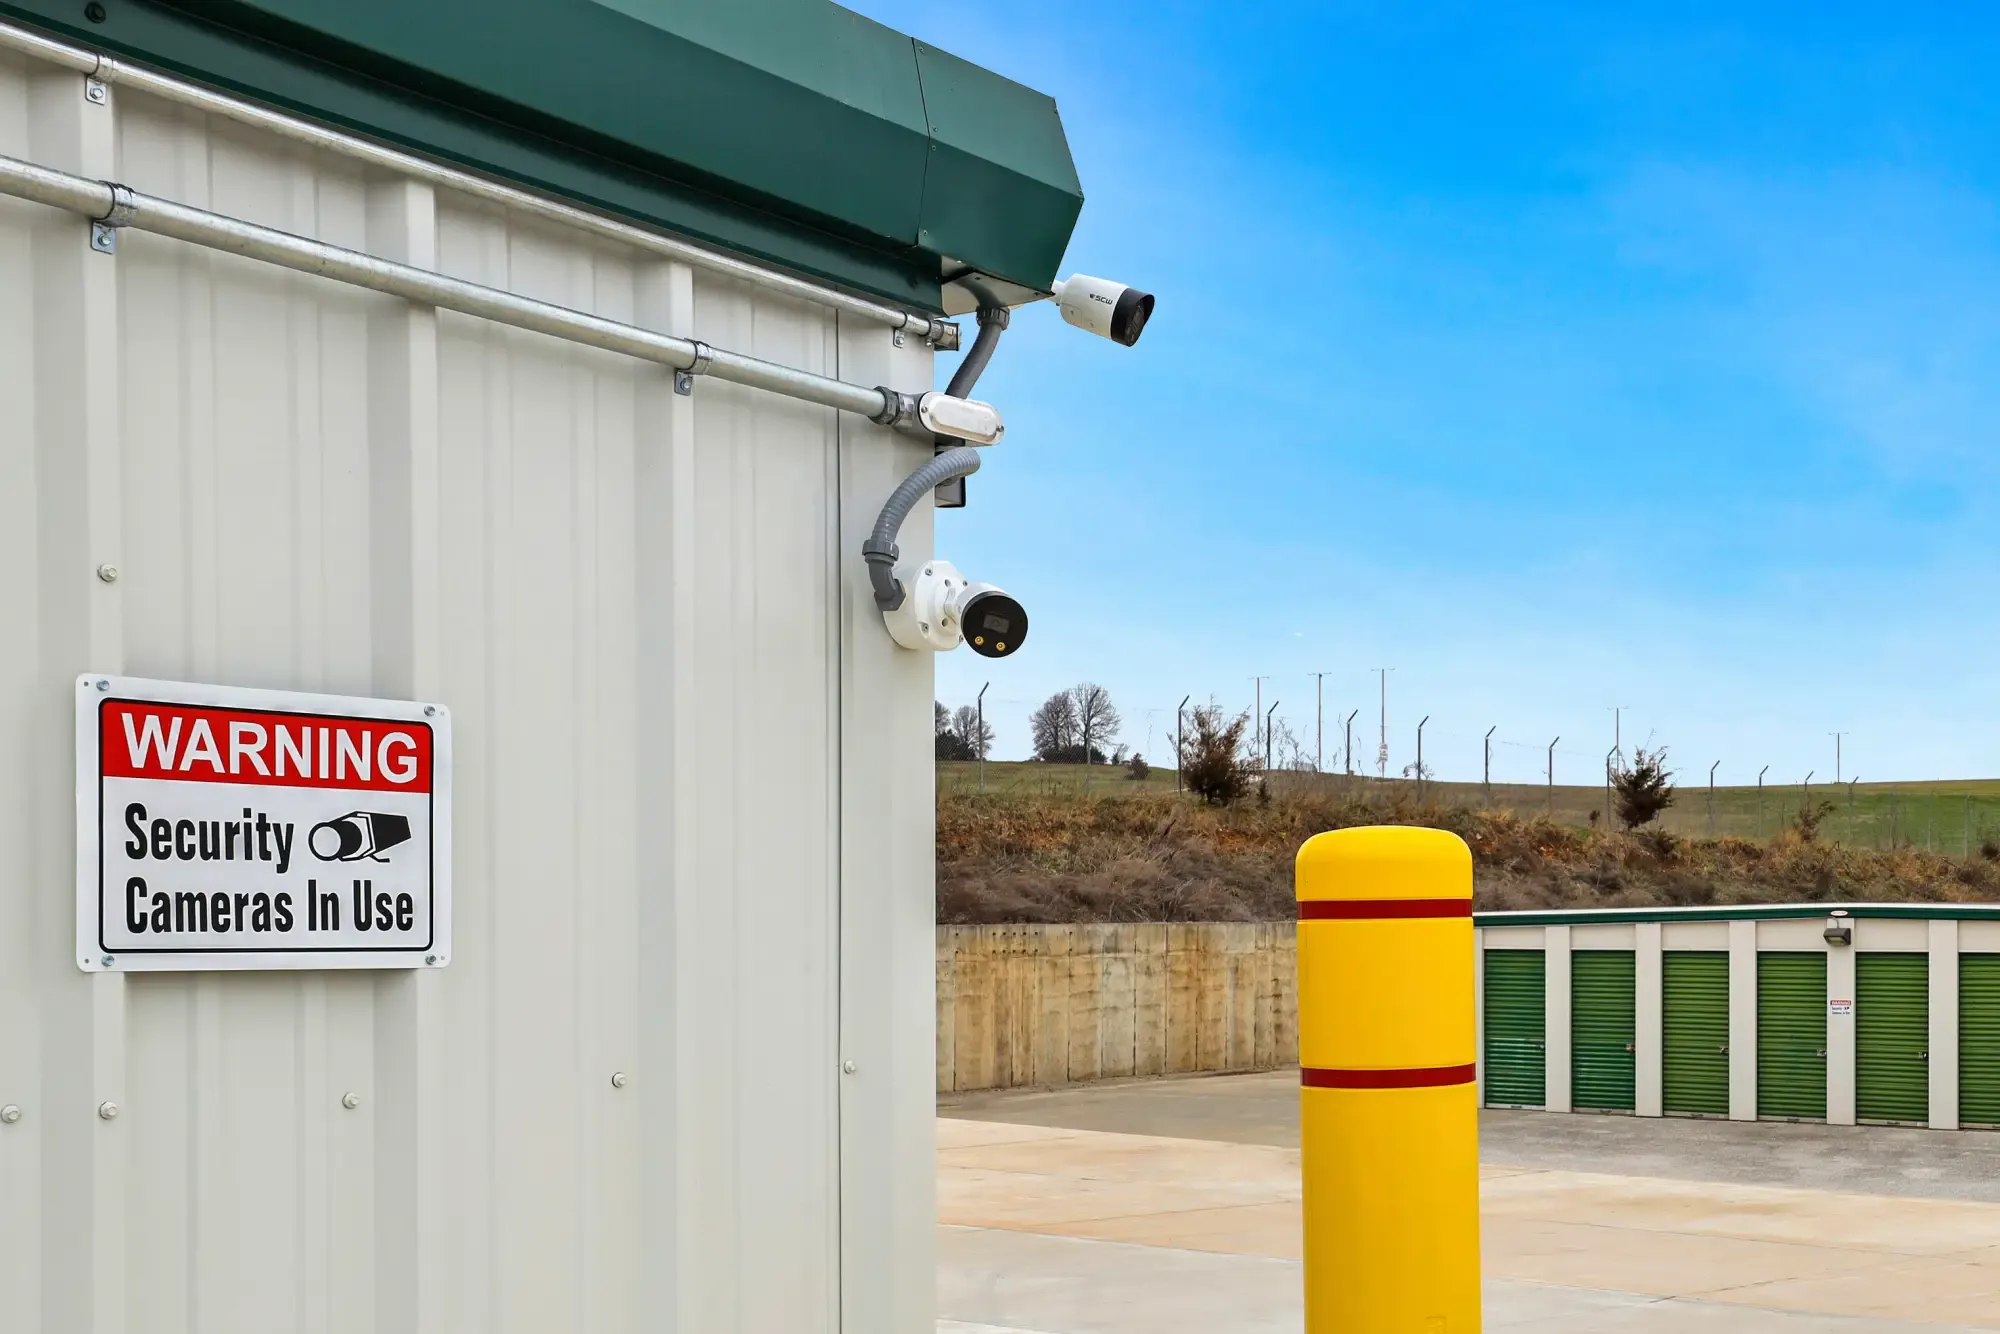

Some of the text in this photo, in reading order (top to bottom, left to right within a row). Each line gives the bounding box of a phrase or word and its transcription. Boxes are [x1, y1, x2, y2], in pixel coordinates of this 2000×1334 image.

[121, 712, 418, 783] WARNING
[125, 802, 294, 874] Security
[126, 876, 414, 934] Cameras In Use
